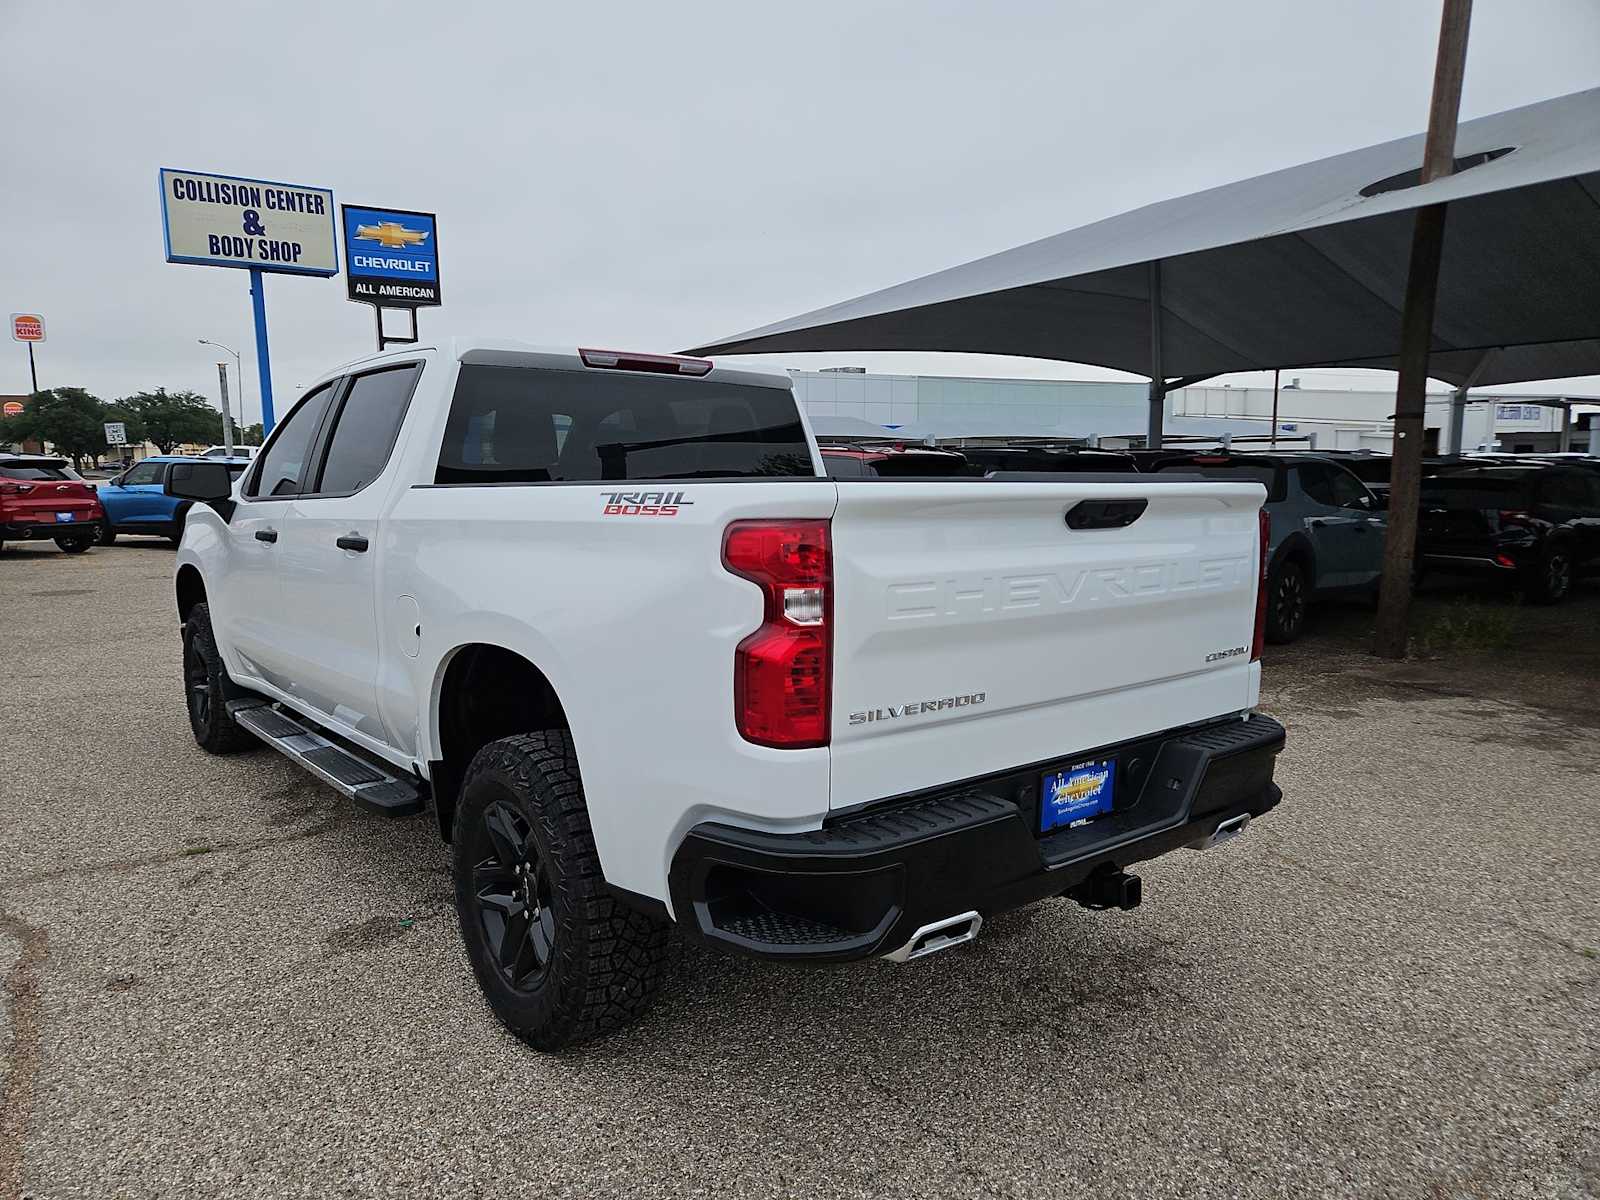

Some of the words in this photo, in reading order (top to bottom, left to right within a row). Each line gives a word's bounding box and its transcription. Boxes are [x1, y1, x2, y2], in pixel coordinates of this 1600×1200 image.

[173, 178, 262, 208] COLLISION
[265, 188, 325, 215] CENTER
[243, 209, 266, 236] &
[208, 234, 254, 258] BODY
[258, 239, 302, 263] SHOP
[353, 255, 431, 273] CHEVROLET
[355, 283, 377, 295] ALL
[379, 285, 434, 299] AMERICAN
[16, 328, 42, 336] KING
[108, 434, 124, 442] 35
[600, 492, 694, 505] TRAIL
[603, 504, 679, 516] BOSS
[886, 555, 1249, 620] CHEVROLET
[1205, 645, 1249, 662] CUSTOM
[849, 691, 986, 726] SILVERADO
[1050, 777, 1065, 793] All
[1068, 769, 1109, 788] American
[1057, 785, 1102, 805] Chevrolet
